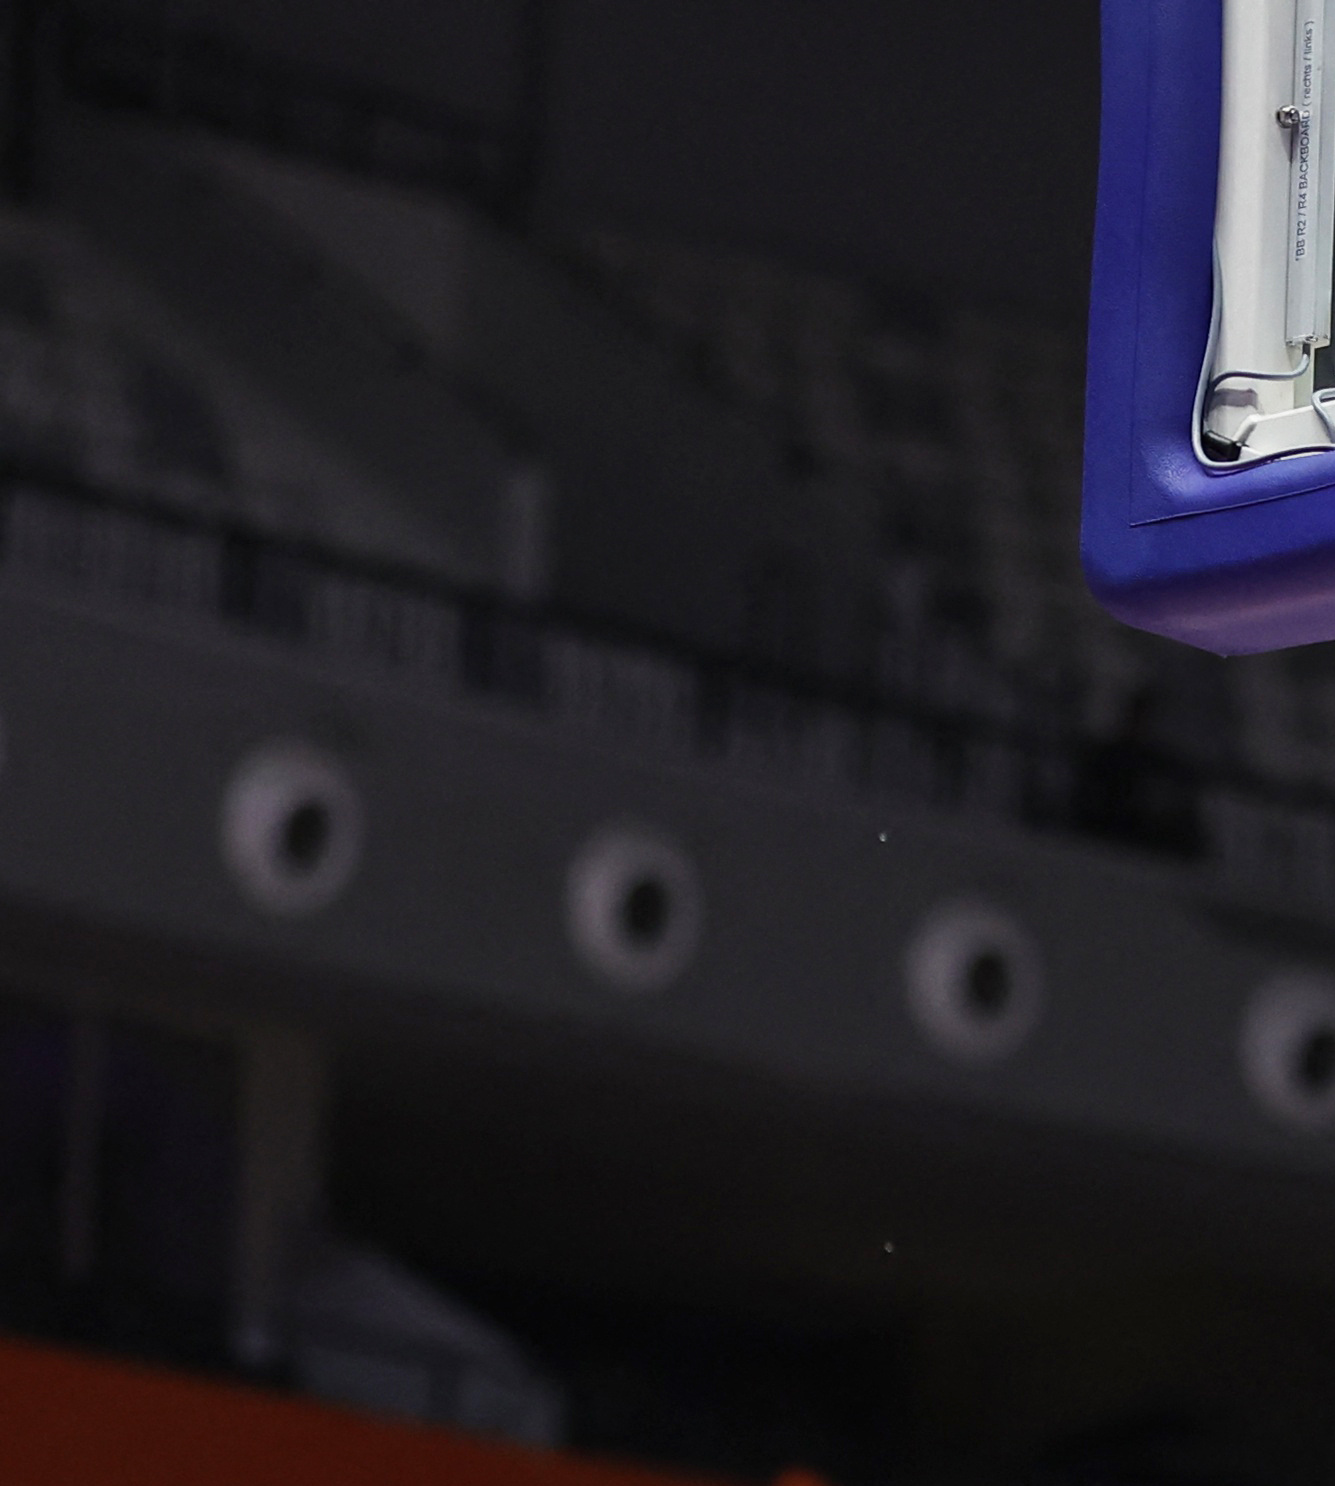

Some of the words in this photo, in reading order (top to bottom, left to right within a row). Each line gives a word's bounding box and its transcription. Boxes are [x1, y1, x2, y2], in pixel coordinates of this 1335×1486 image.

[1303, 29, 1313, 55] links
[1302, 65, 1312, 98] rechts
[1299, 110, 1311, 189] BACKBOARD
[1299, 193, 1308, 209] R4
[1297, 220, 1307, 236] R2
